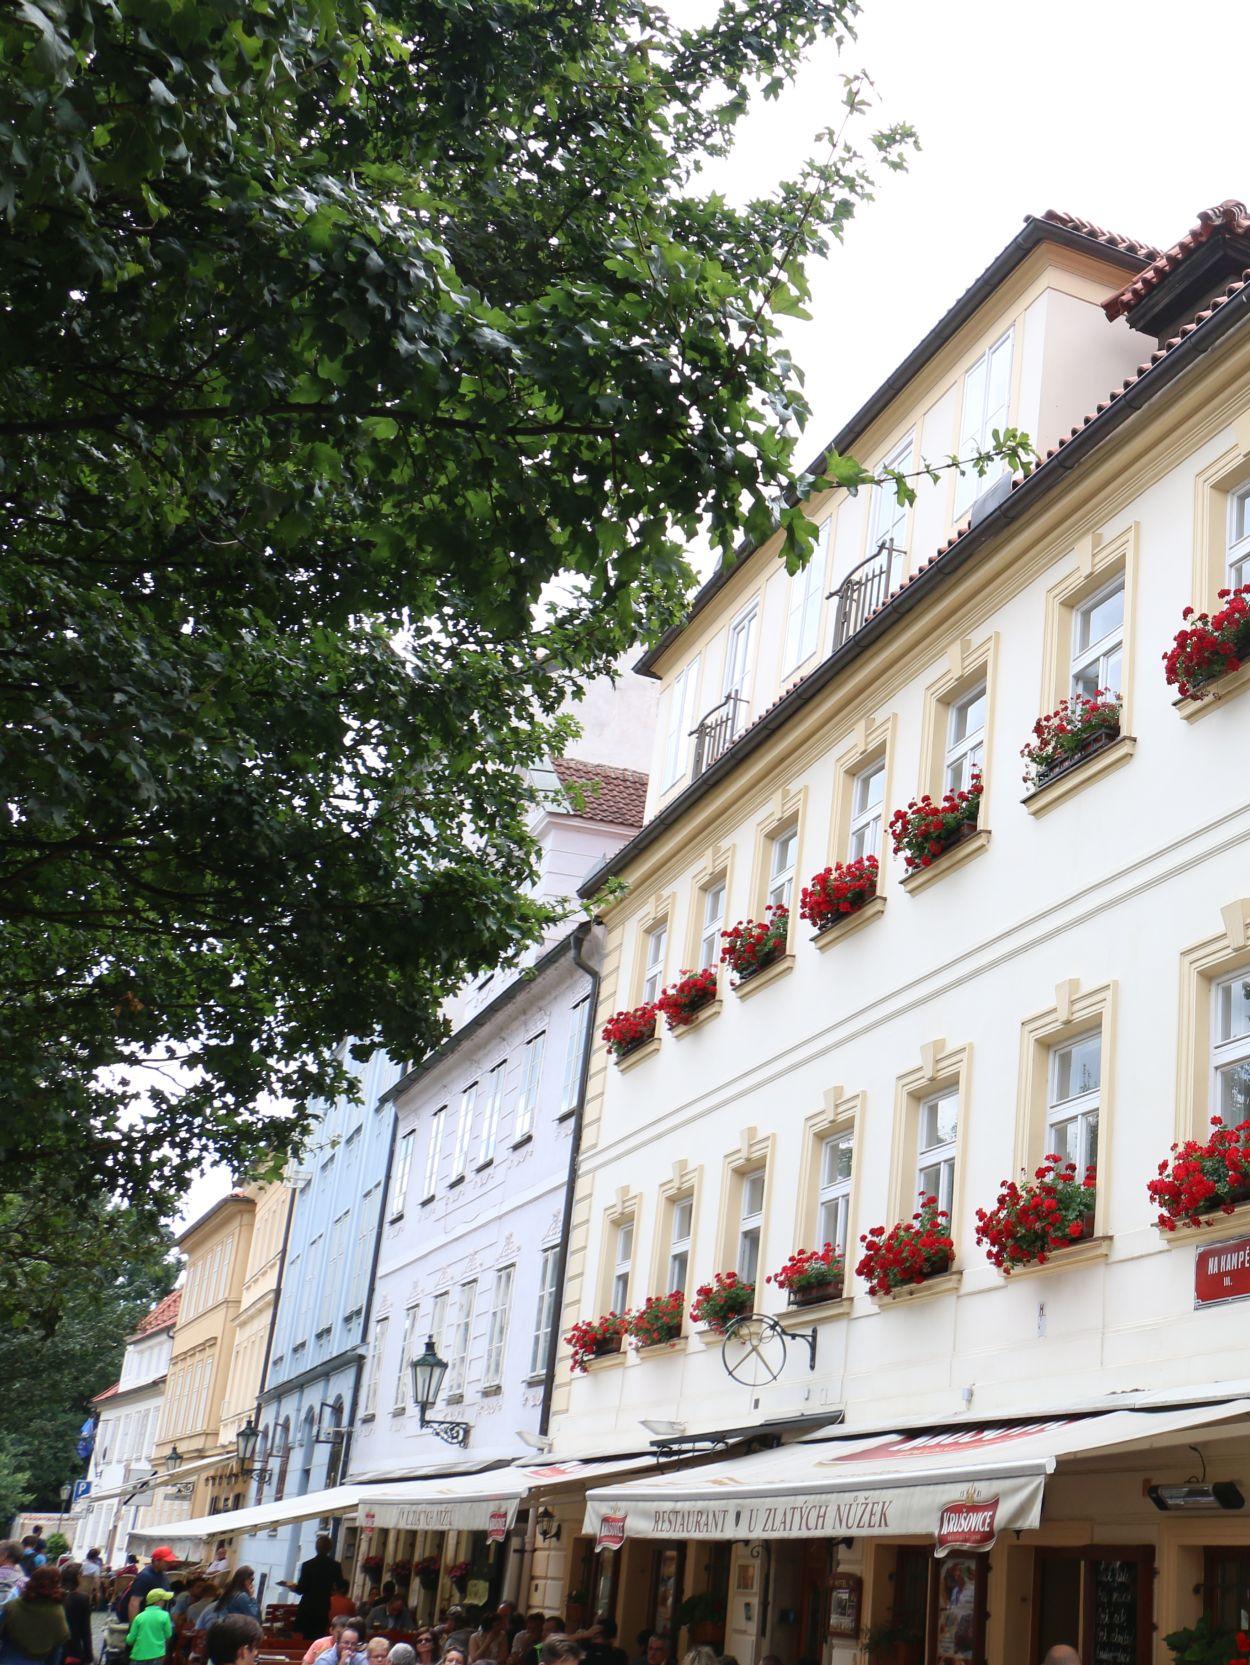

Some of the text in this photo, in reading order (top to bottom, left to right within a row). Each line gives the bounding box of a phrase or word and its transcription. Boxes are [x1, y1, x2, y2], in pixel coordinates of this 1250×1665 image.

[1208, 1256, 1218, 1275] NA
[78, 1483, 87, 1495] P
[652, 1495, 894, 1534] RESTAURANT U ZLATÝCH NŮŽEK
[940, 1508, 993, 1535] KRUŠOVICE
